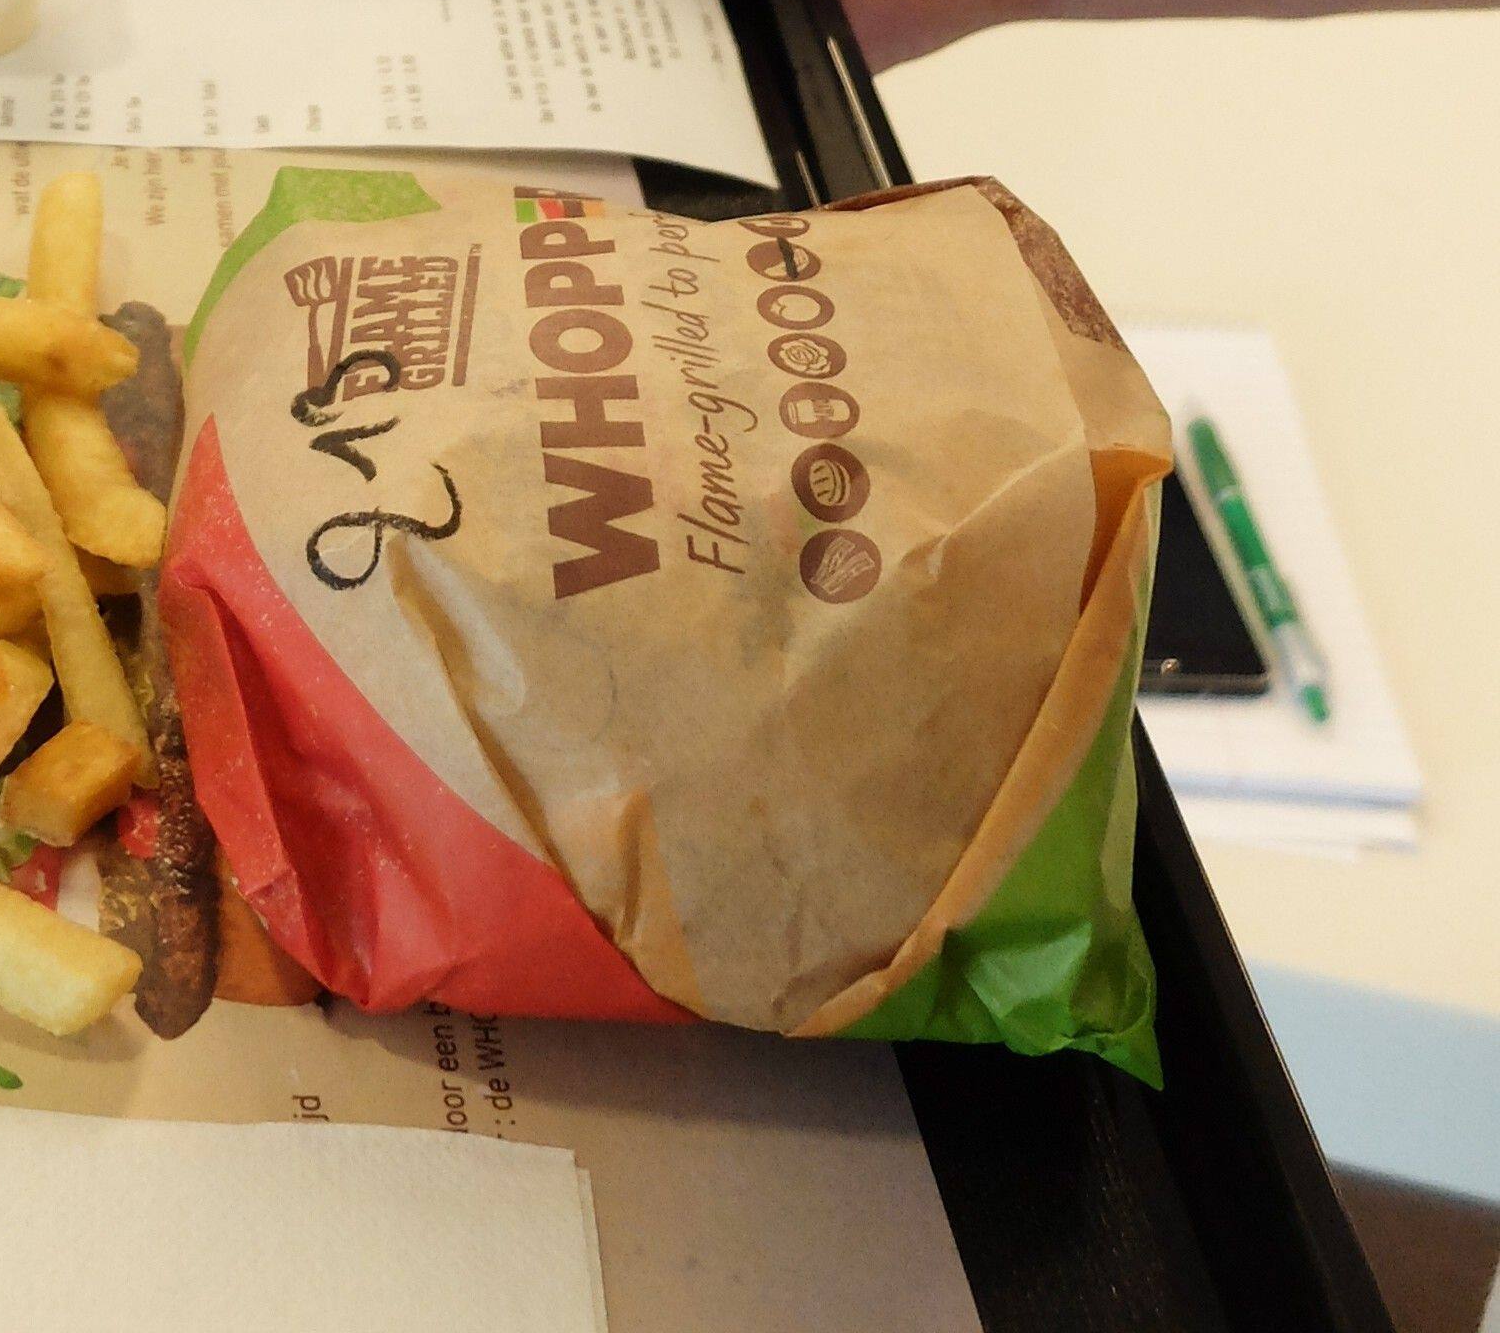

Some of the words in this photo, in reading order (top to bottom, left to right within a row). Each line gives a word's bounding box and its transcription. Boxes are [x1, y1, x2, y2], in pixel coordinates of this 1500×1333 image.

[342, 255, 416, 402] FLAME
[398, 255, 459, 391] GRILLED
[648, 267, 699, 299] to
[641, 299, 758, 575] Flame-grilled
[432, 1024, 459, 1072] een
[483, 1078, 513, 1111] de
